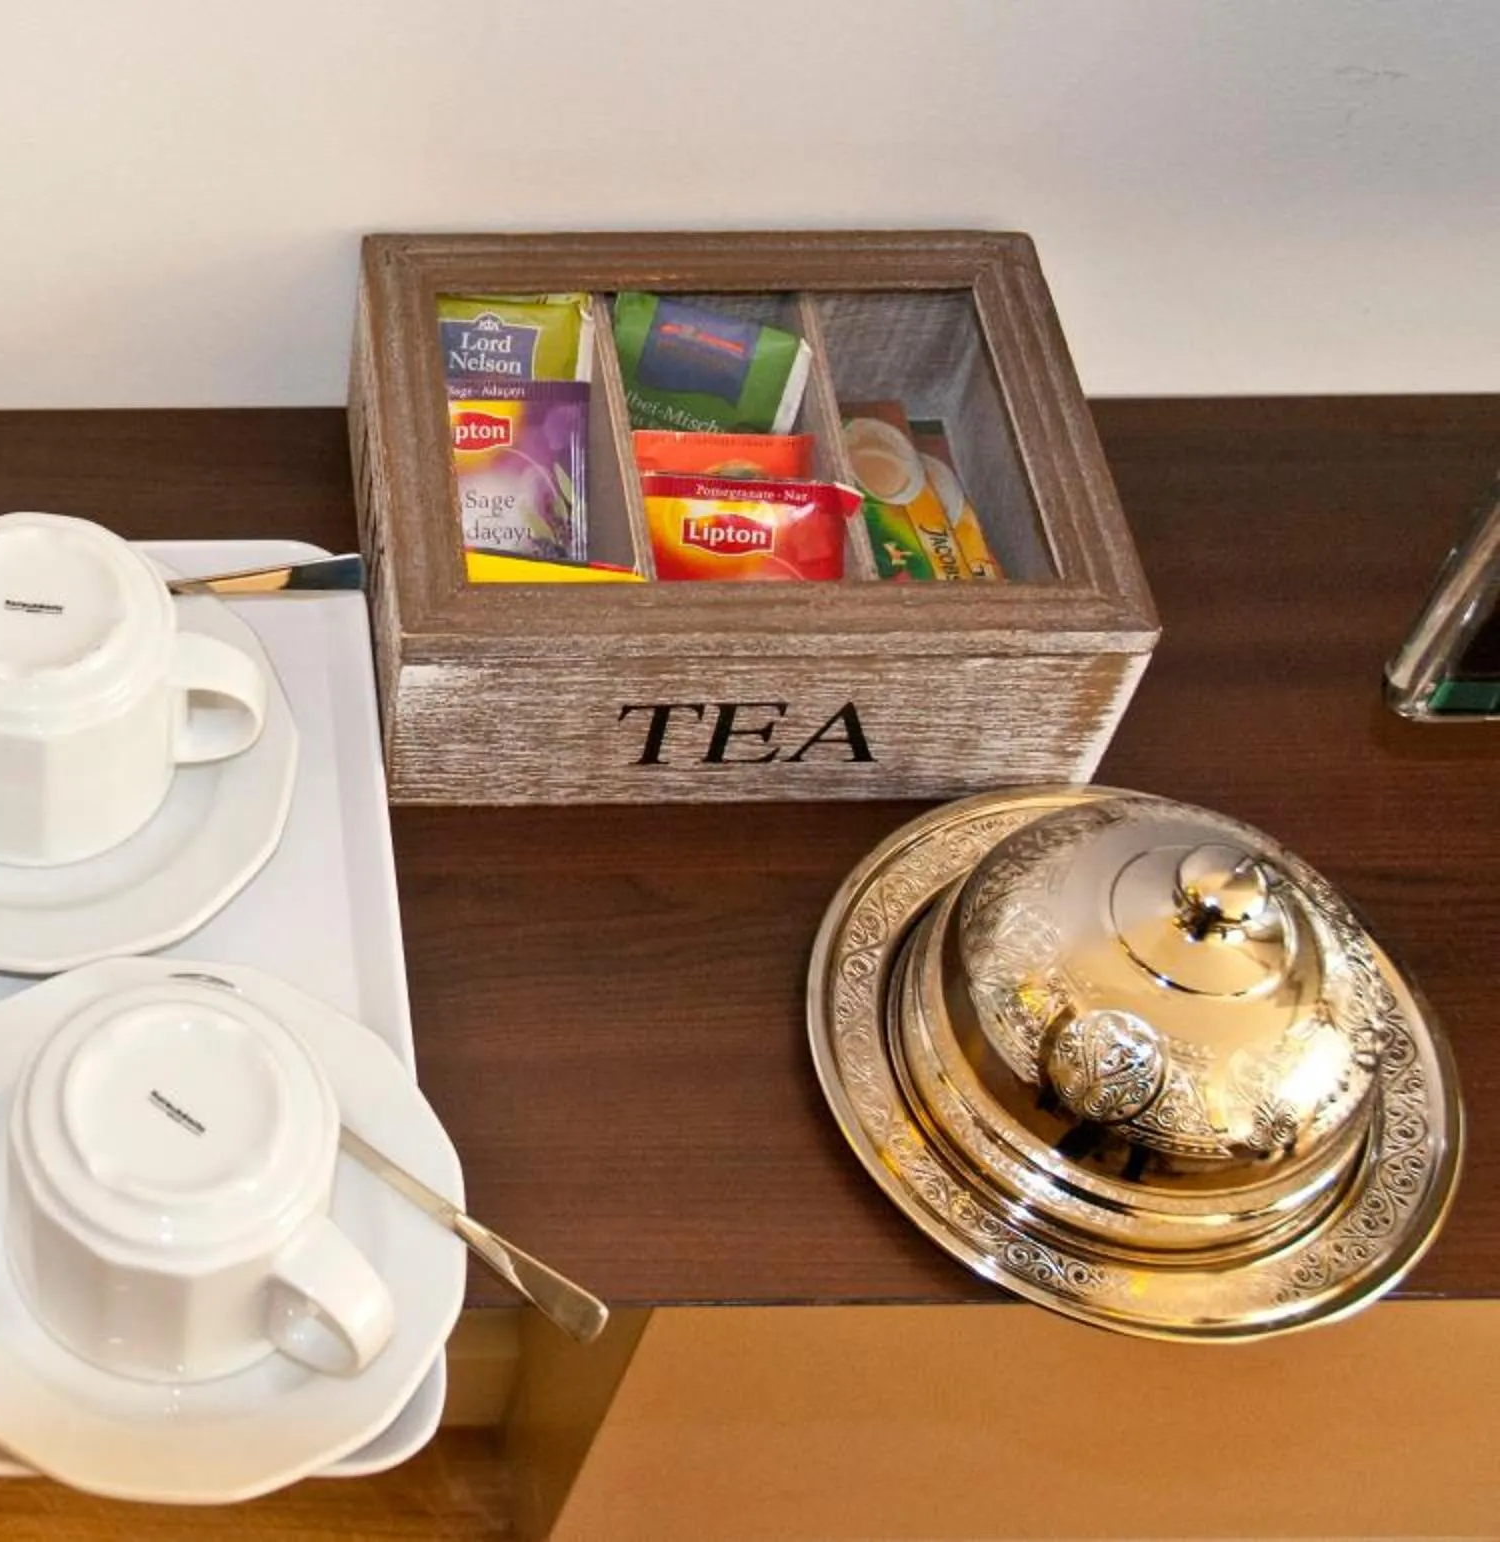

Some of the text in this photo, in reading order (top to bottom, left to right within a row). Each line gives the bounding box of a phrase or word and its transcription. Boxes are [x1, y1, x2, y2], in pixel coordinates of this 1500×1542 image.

[461, 331, 513, 354] Lord
[448, 352, 522, 375] Nelson
[452, 421, 505, 445] pton
[465, 490, 515, 516] Sage
[696, 484, 775, 500] Pomegranate
[689, 520, 767, 546] Lipton
[617, 700, 880, 765] TEA
